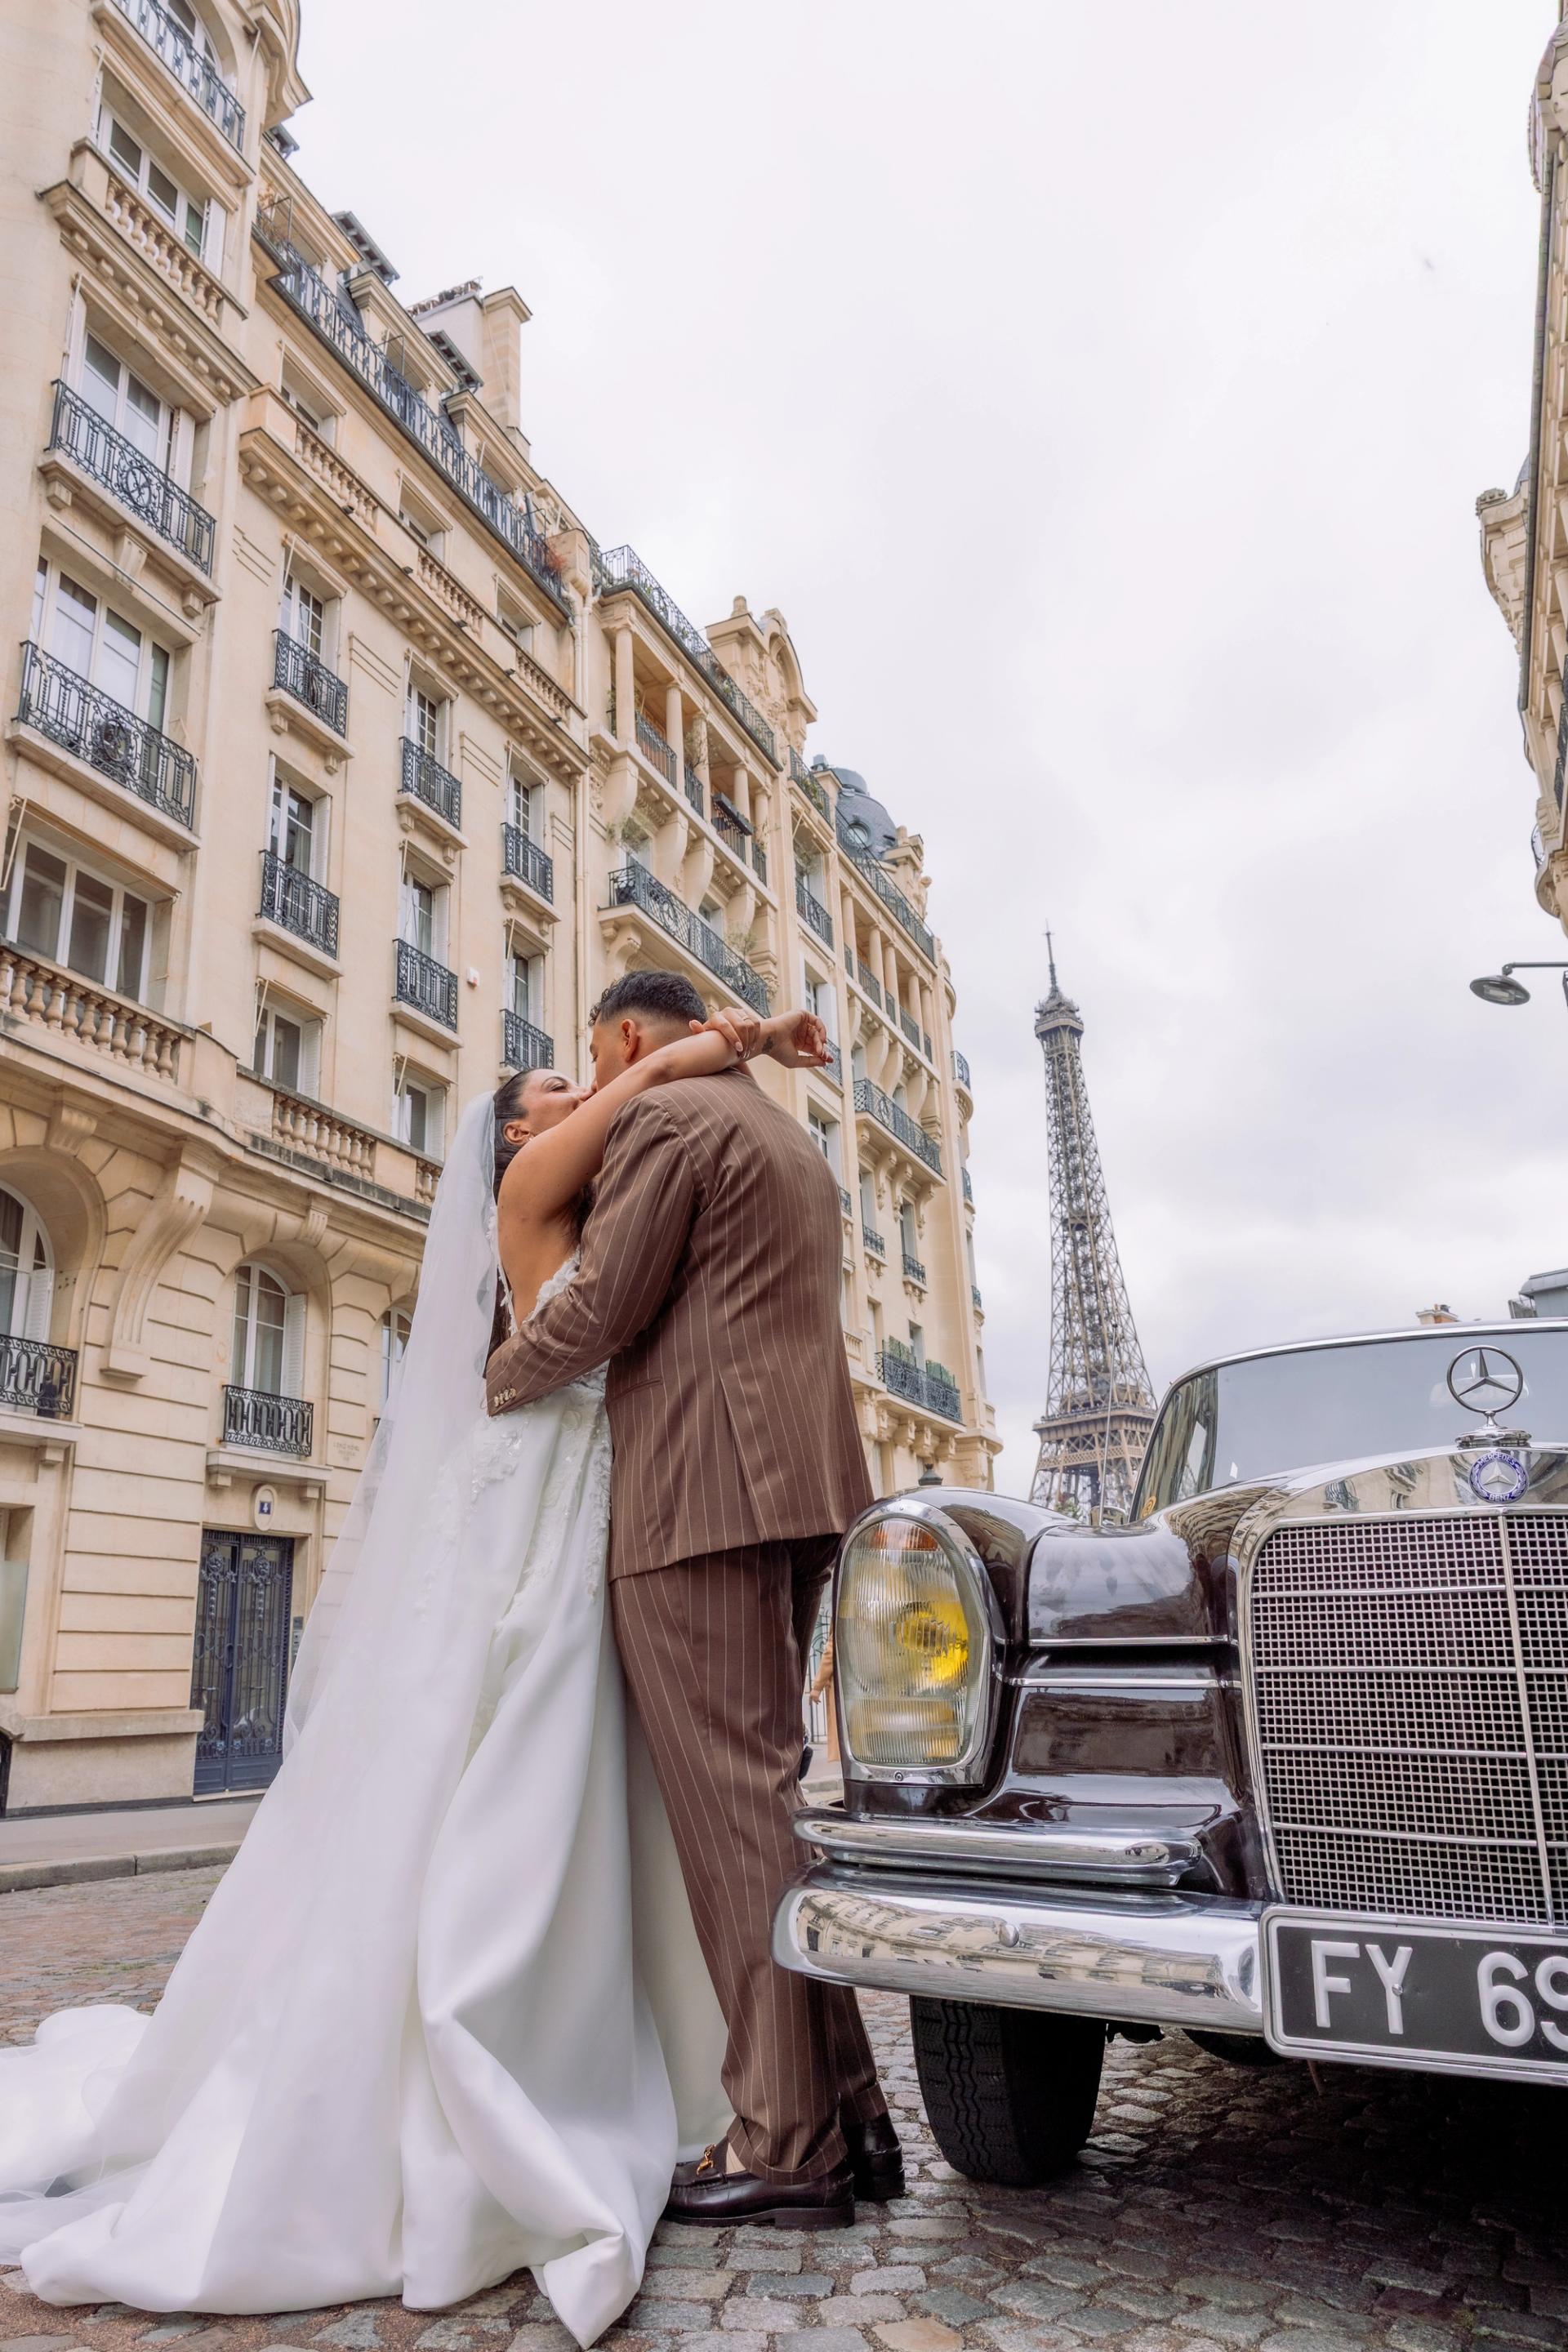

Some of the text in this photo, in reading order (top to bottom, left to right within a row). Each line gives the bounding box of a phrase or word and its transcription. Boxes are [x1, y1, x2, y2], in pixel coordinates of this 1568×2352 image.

[1477, 1452, 1515, 1466] MERCEDES
[1489, 1494, 1510, 1502] BENZ
[262, 1502, 269, 1513] 4
[1311, 1940, 1413, 2034] FY
